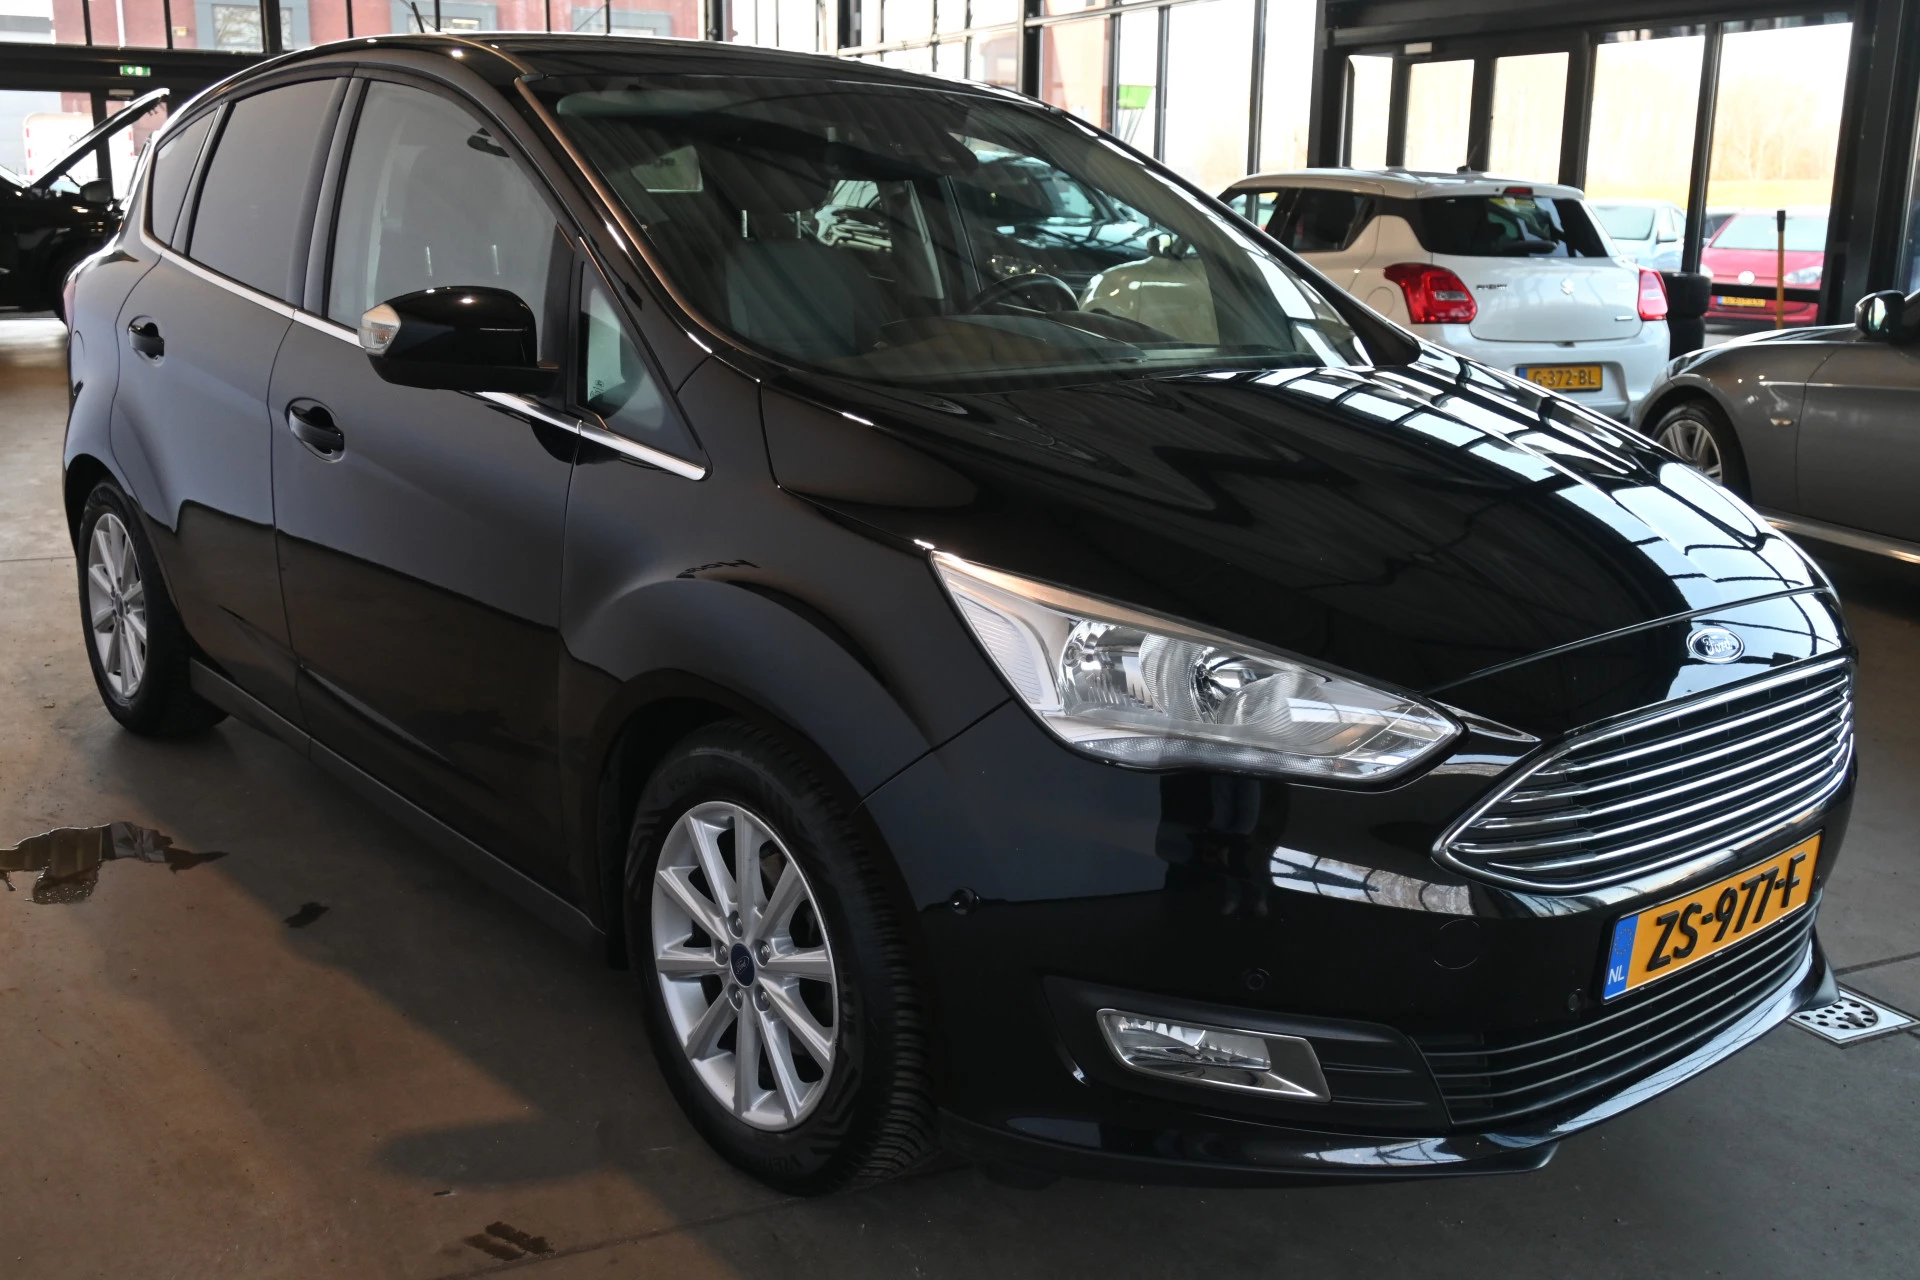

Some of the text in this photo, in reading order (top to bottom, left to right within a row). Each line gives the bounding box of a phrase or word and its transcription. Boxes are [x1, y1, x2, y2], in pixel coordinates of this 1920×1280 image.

[1533, 369, 1595, 386] G-372-BL
[1702, 635, 1736, 655] Ford
[1645, 852, 1806, 972] ZS-977-F
[1608, 965, 1624, 985] NL
